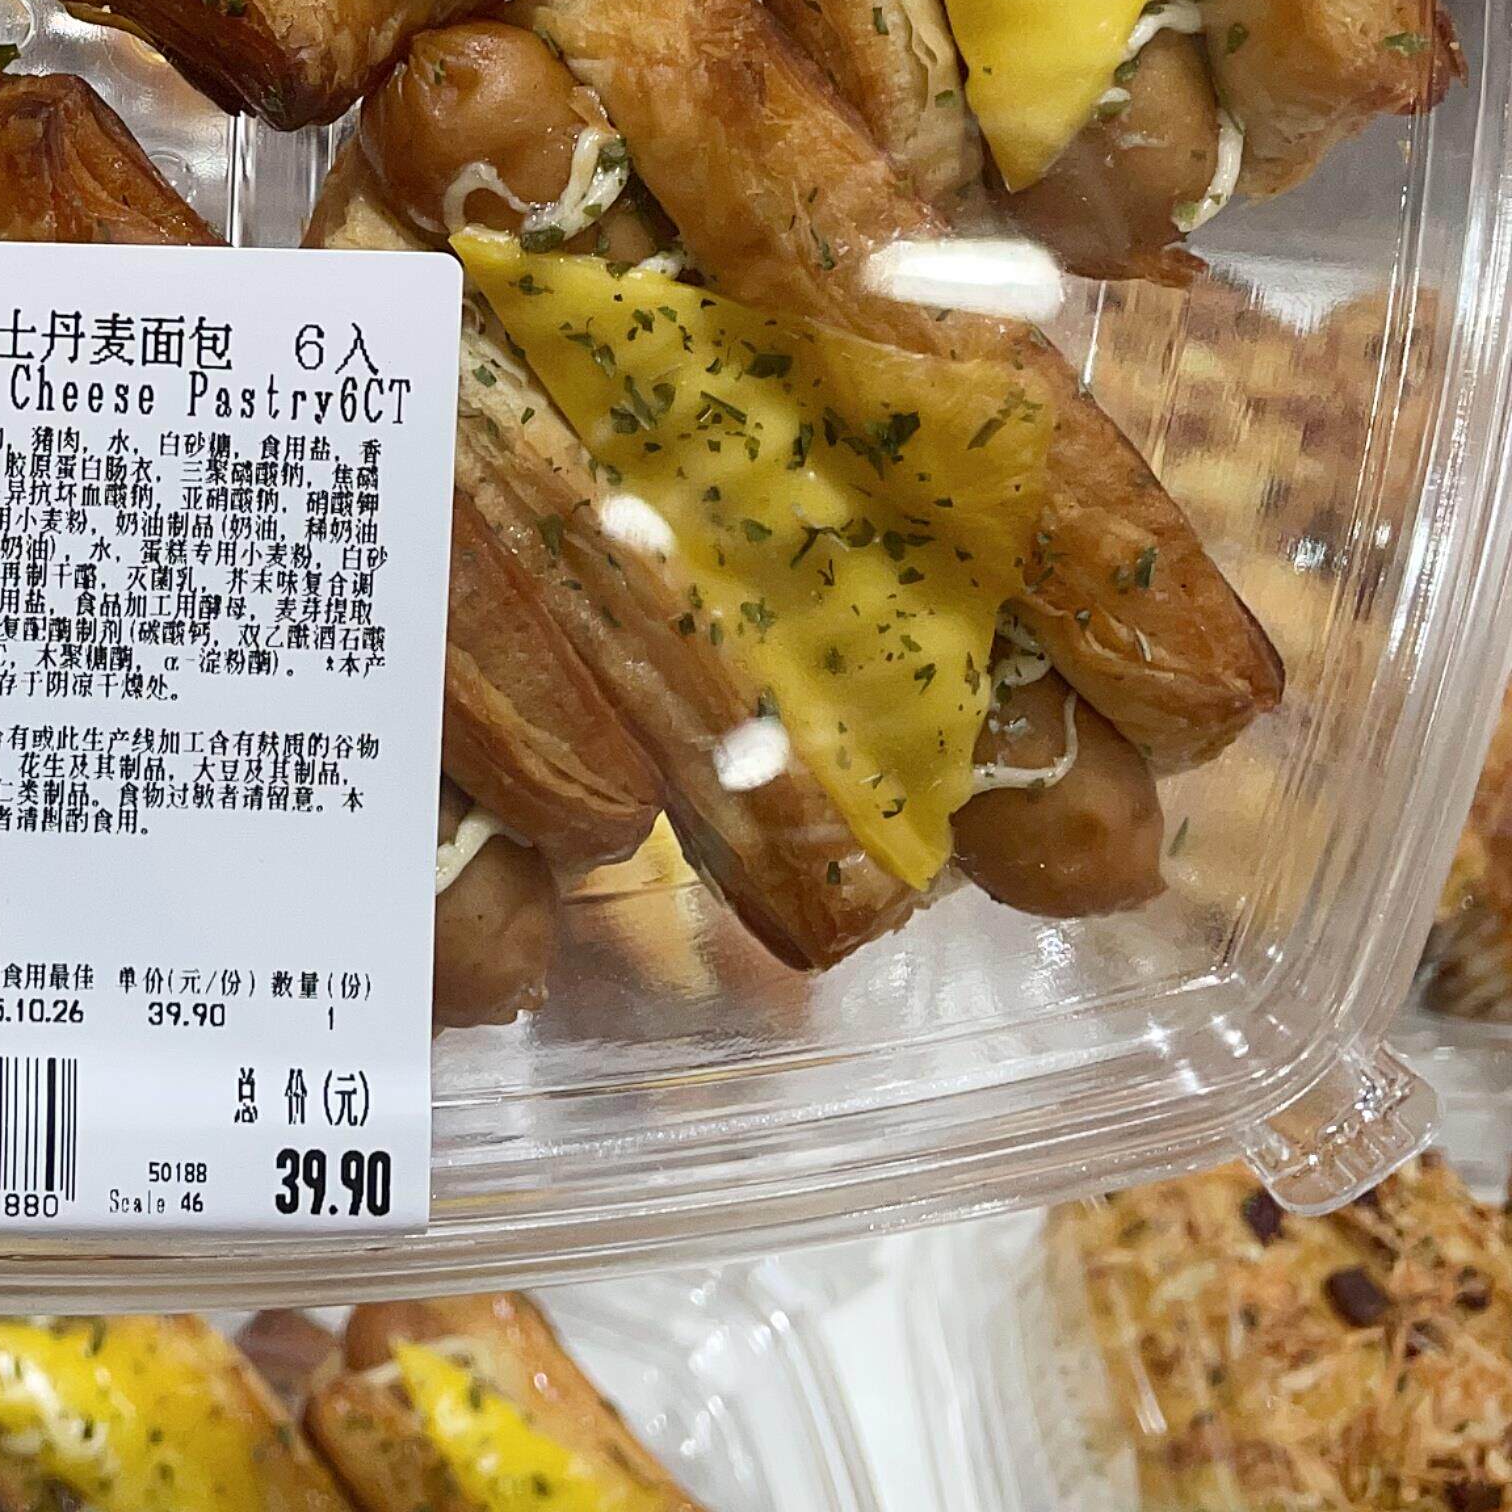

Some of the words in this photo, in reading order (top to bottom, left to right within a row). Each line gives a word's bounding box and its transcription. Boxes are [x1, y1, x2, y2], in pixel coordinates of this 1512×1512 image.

[11, 365, 155, 416] Cheese
[188, 371, 412, 425] Pastry6CT
[148, 1002, 225, 1028] 39.90
[327, 1007, 335, 1031] 1
[148, 1162, 207, 1183] 50188
[275, 1149, 392, 1217] 39.90
[109, 1189, 166, 1215] Scale
[180, 1193, 204, 1214] 46
